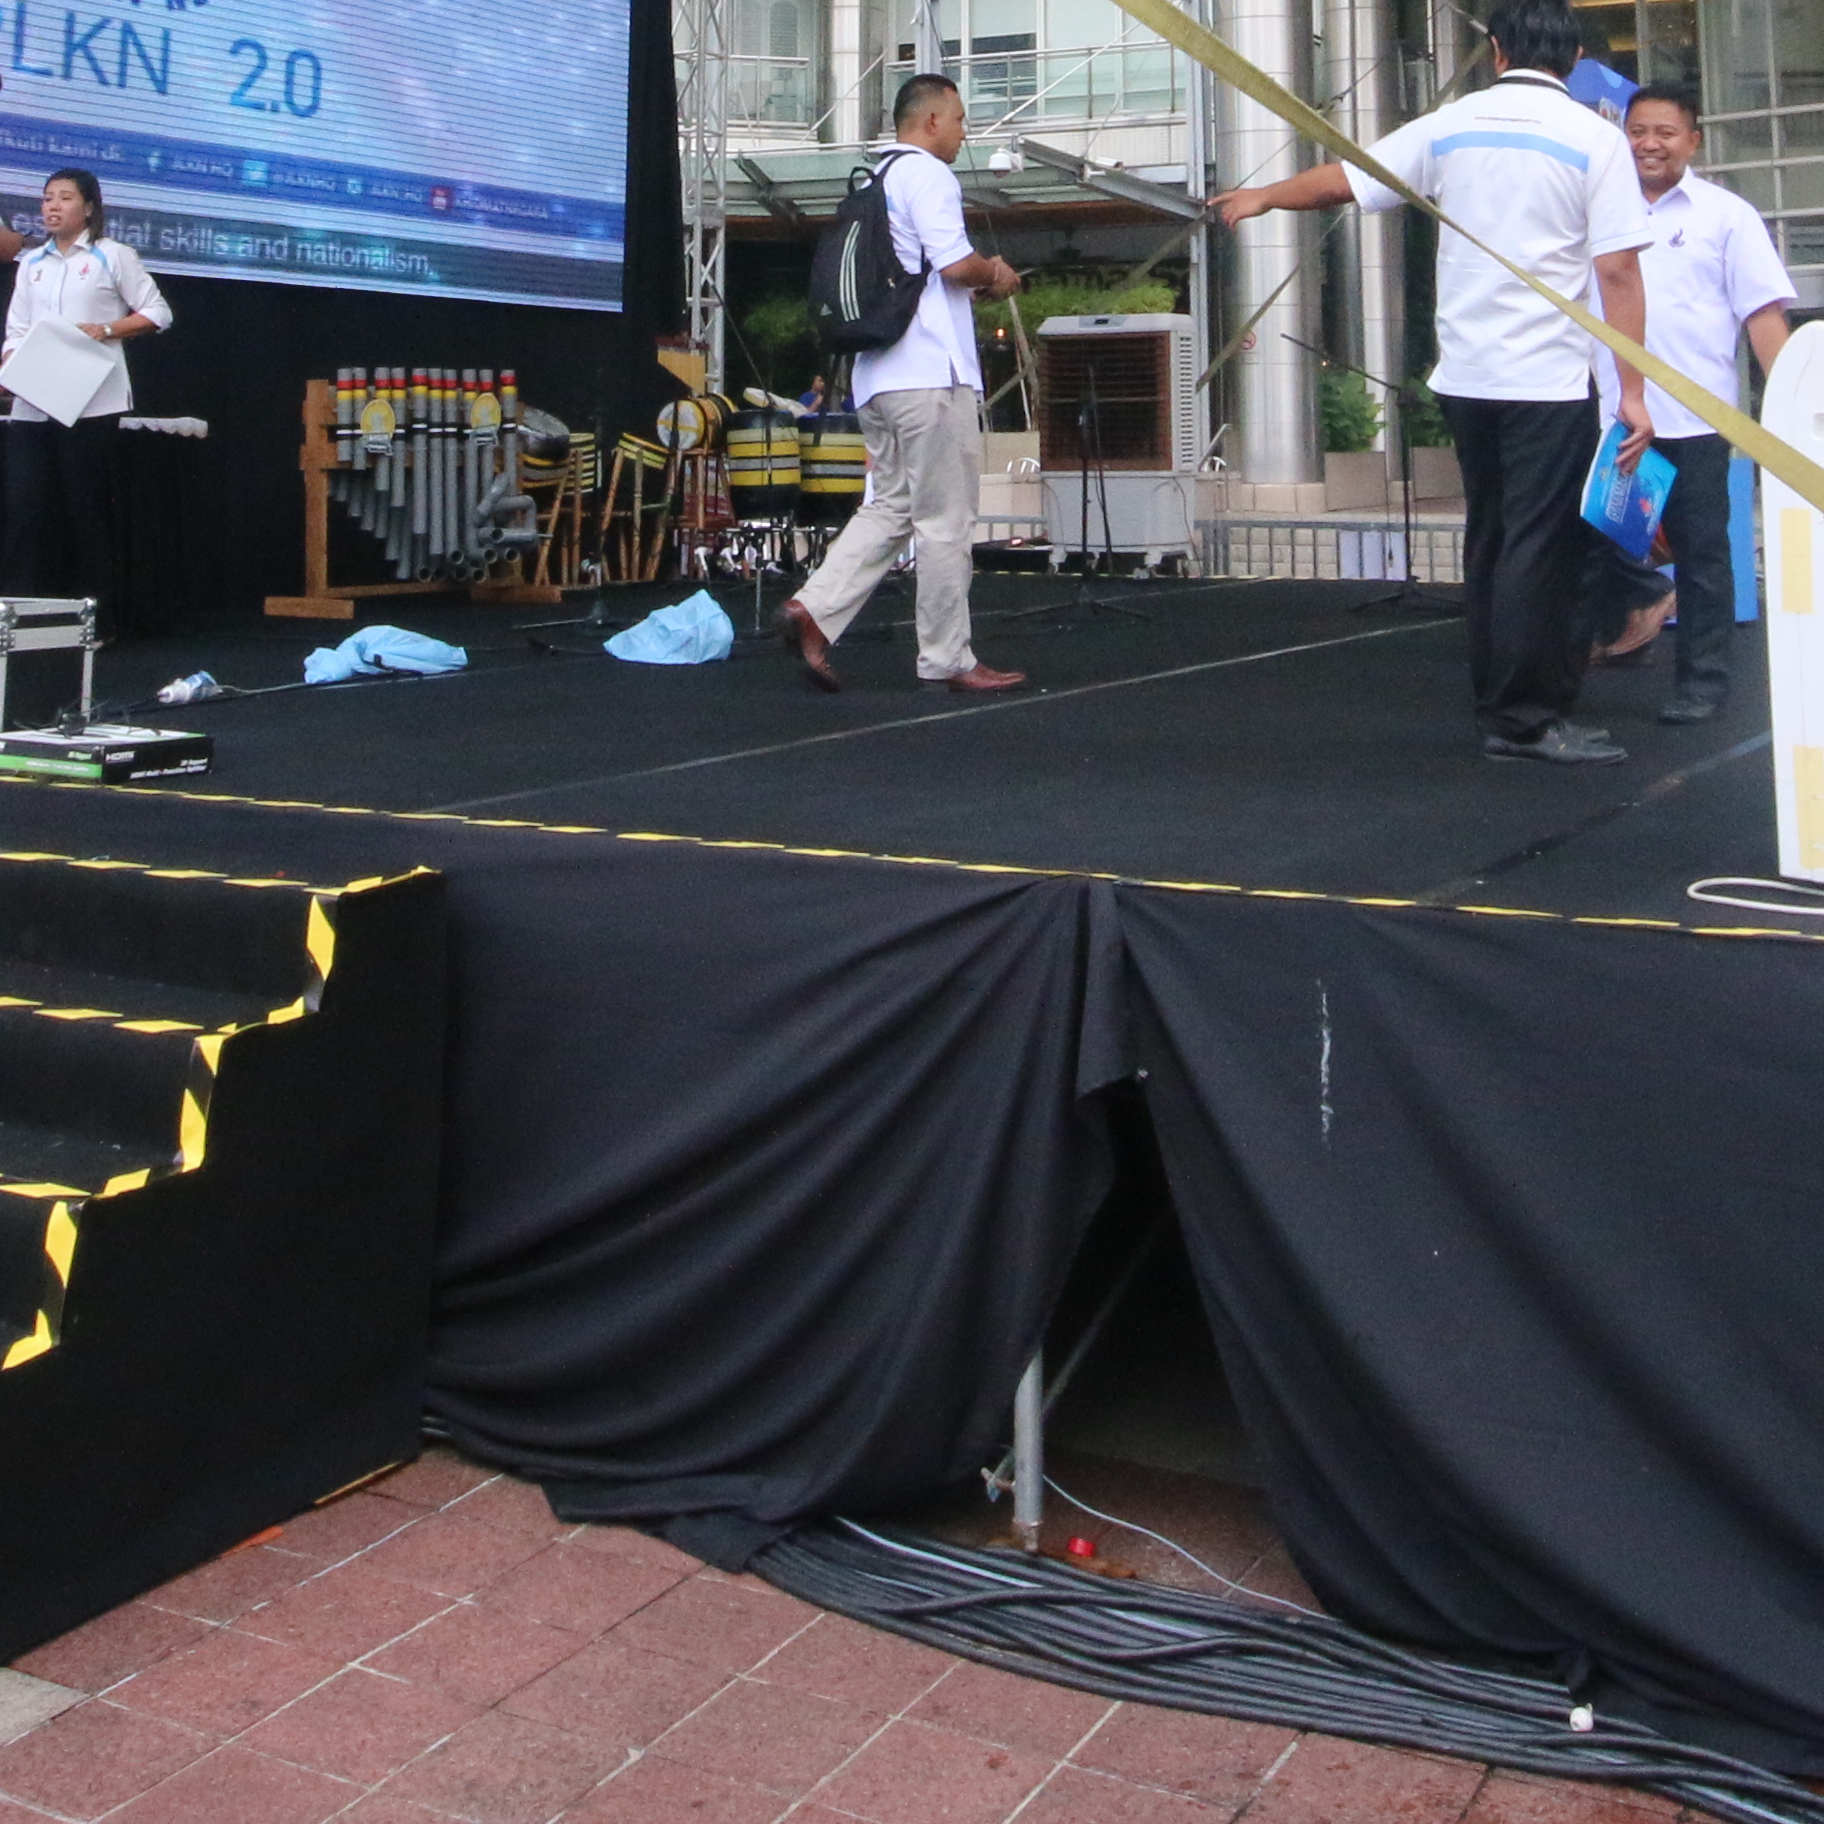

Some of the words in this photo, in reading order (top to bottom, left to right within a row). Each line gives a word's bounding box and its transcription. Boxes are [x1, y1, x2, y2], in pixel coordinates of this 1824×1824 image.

[229, 37, 323, 118] 2.0
[159, 224, 229, 257] skills
[234, 234, 289, 262] and
[105, 751, 136, 763] HDMI
